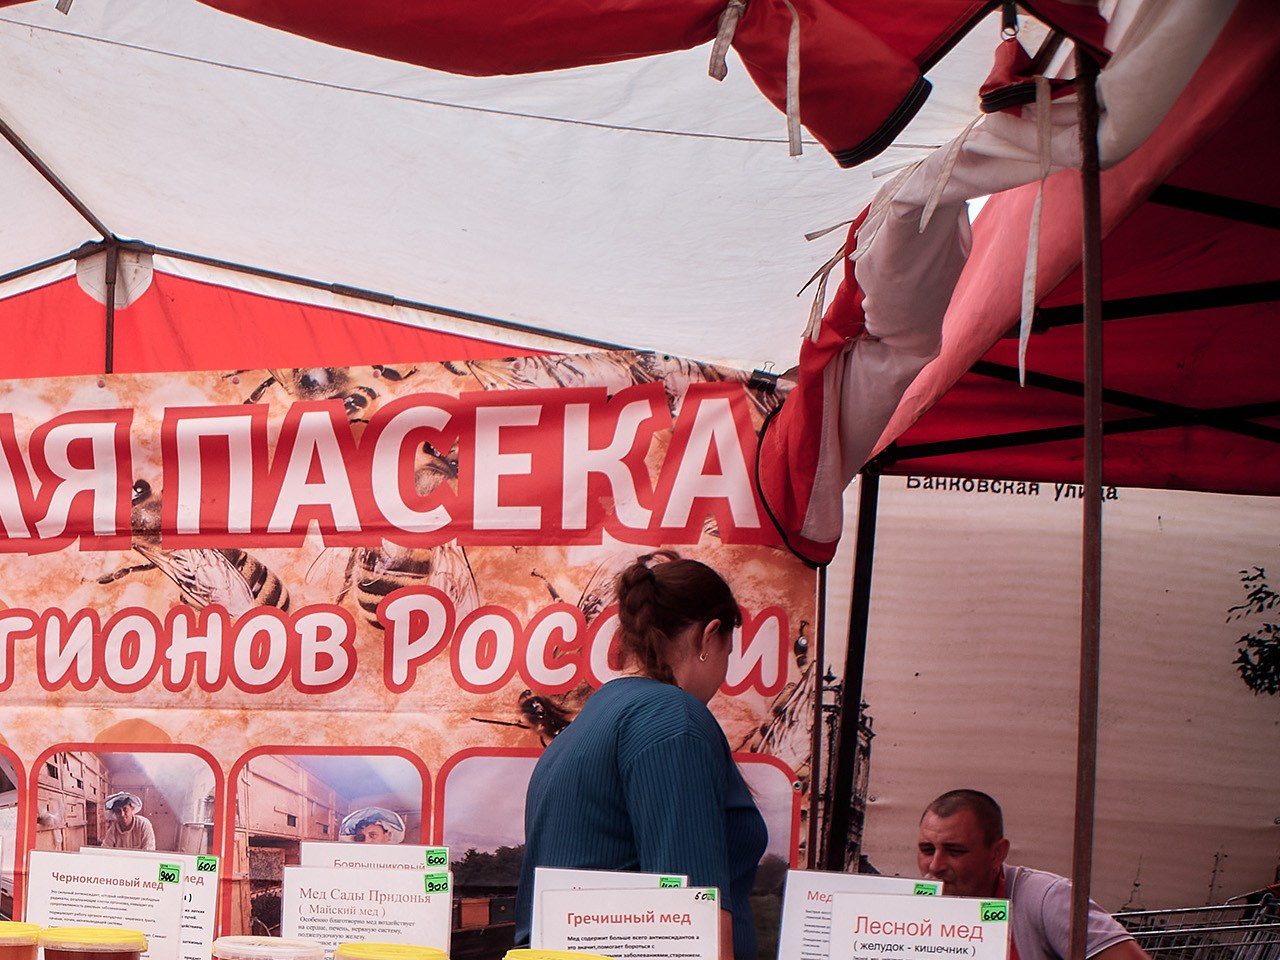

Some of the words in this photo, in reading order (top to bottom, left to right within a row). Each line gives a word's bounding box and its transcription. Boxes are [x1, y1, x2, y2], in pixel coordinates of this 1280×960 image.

[174, 397, 762, 536] ПАСЕКА
[907, 475, 1040, 495] Банковская
[1054, 483, 1119, 502] улиа
[385, 599, 780, 688] Росси
[198, 861, 217, 871] 600
[427, 855, 445, 864] 600
[52, 871, 140, 889] Чернокленовый
[142, 880, 165, 892] мед
[427, 882, 448, 892] 900
[299, 887, 327, 901] Мед
[330, 888, 365, 901] Сады
[368, 889, 431, 905] Придонья
[807, 890, 833, 903] Мед
[309, 903, 356, 915] Майский
[359, 908, 379, 917] мед
[983, 910, 1005, 920] 600
[567, 910, 655, 928] Гречишный
[659, 913, 692, 926] мед
[853, 915, 933, 937] Лесной
[939, 923, 983, 942] мед
[859, 942, 905, 954] желудок
[914, 944, 969, 955] кишечник
